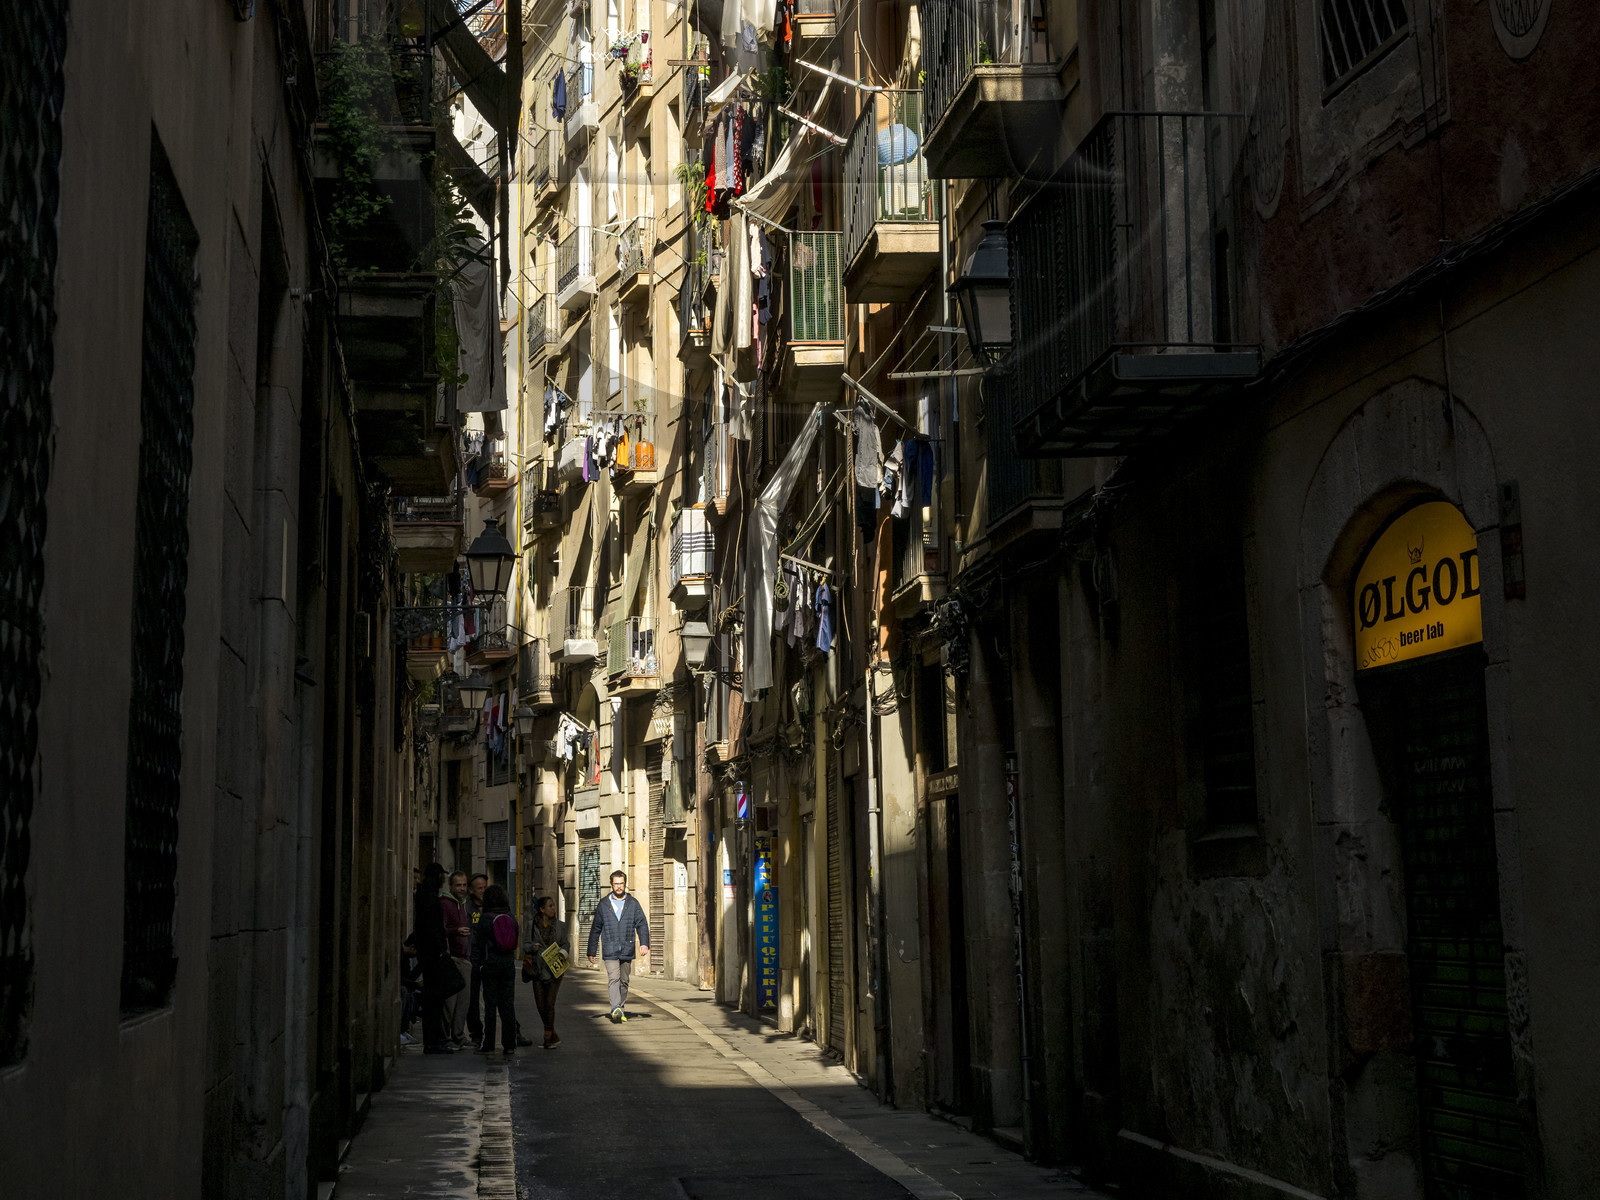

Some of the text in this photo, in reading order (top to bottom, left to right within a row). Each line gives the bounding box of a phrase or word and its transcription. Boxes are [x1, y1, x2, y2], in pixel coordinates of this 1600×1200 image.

[1400, 622, 1444, 647] beer lab
[762, 904, 776, 1007] PELUQUERIA
